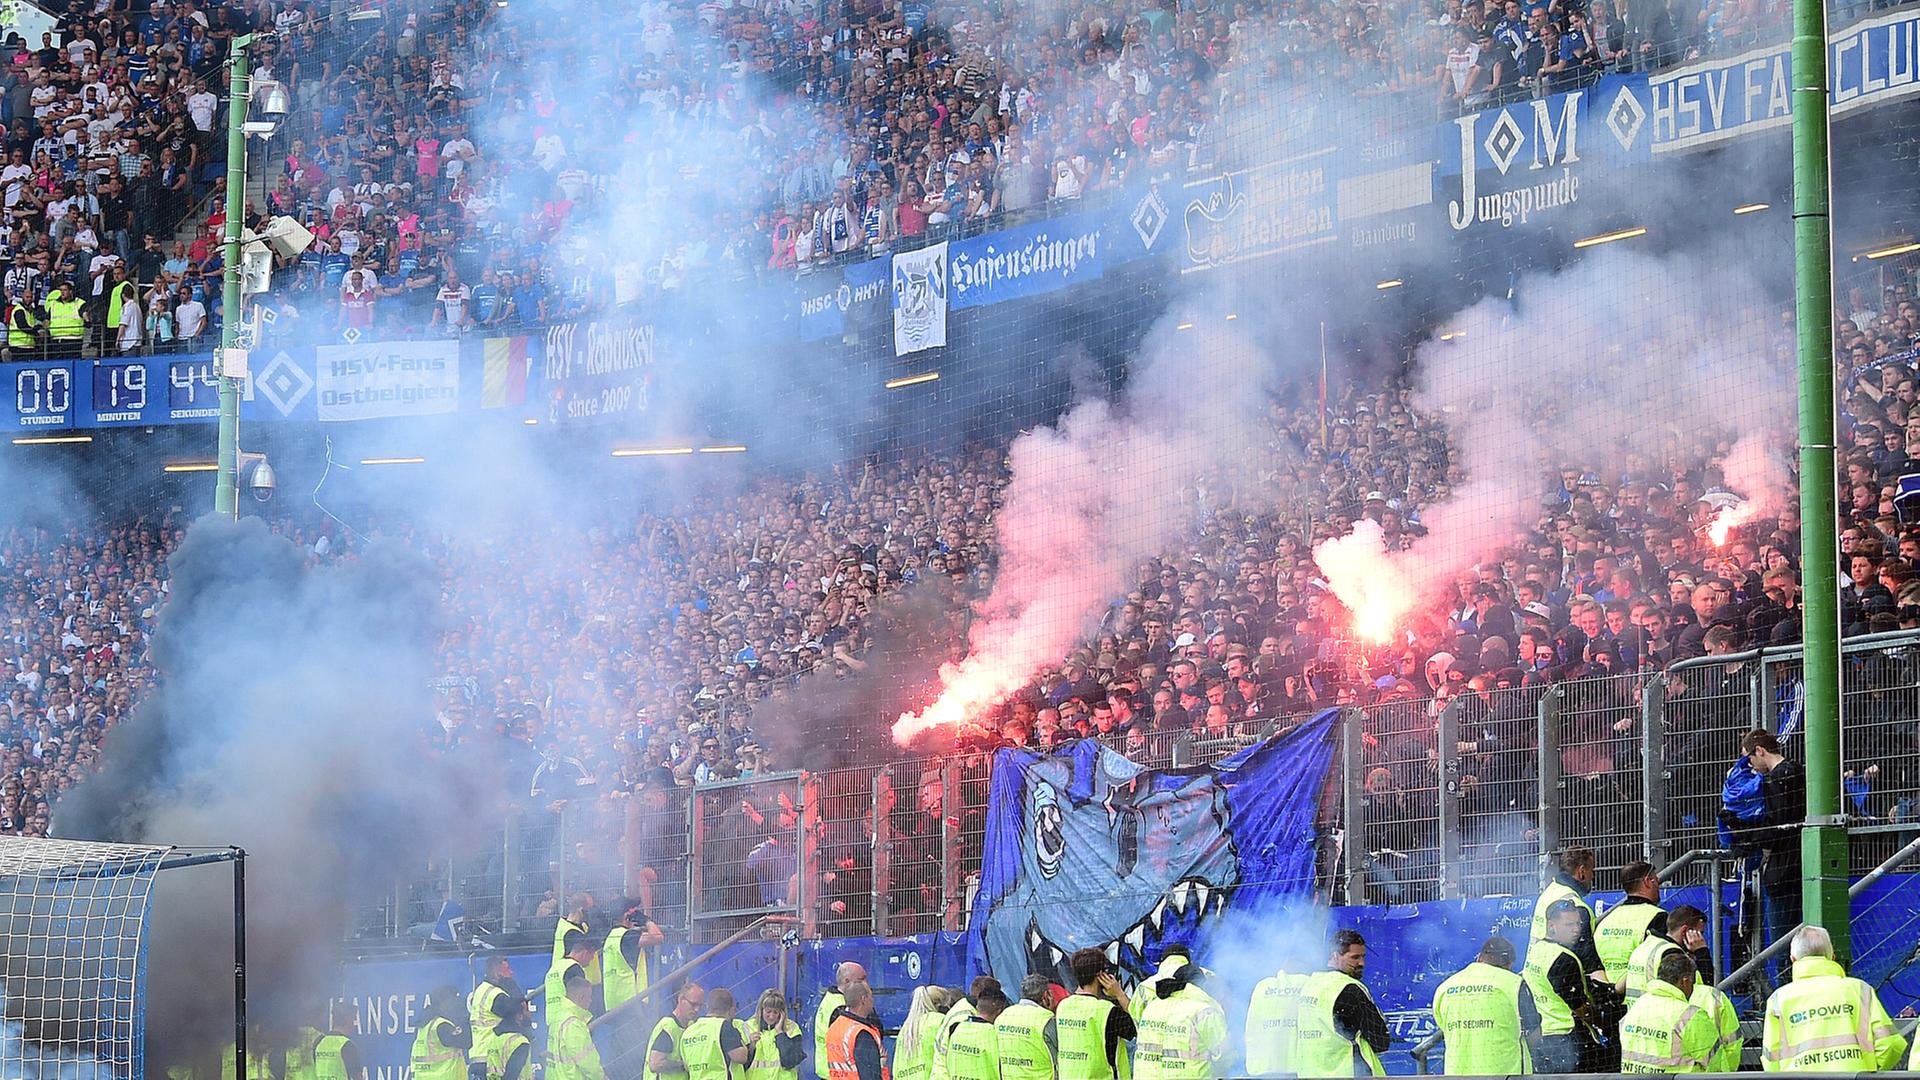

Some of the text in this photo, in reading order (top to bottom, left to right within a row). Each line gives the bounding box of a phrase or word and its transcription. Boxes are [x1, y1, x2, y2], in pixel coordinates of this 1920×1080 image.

[1651, 19, 1920, 143] HSV FA CLU
[545, 322, 578, 380] HSV
[331, 354, 446, 378] HSV-Fans
[111, 364, 146, 409] 19
[321, 384, 455, 407] Ostbelgien
[567, 385, 631, 418] since 2009
[20, 407, 221, 425] STUNDEN MINUTEN SEKUNDEN
[1459, 984, 1494, 993] POWER
[1808, 1003, 1854, 1018] POWER
[1007, 1025, 1031, 1036] POWER
[1064, 1018, 1087, 1029] POWER
[1463, 1019, 1495, 1029] SECURITY
[1635, 1025, 1669, 1041] POWER
[957, 1043, 980, 1055] POWER
